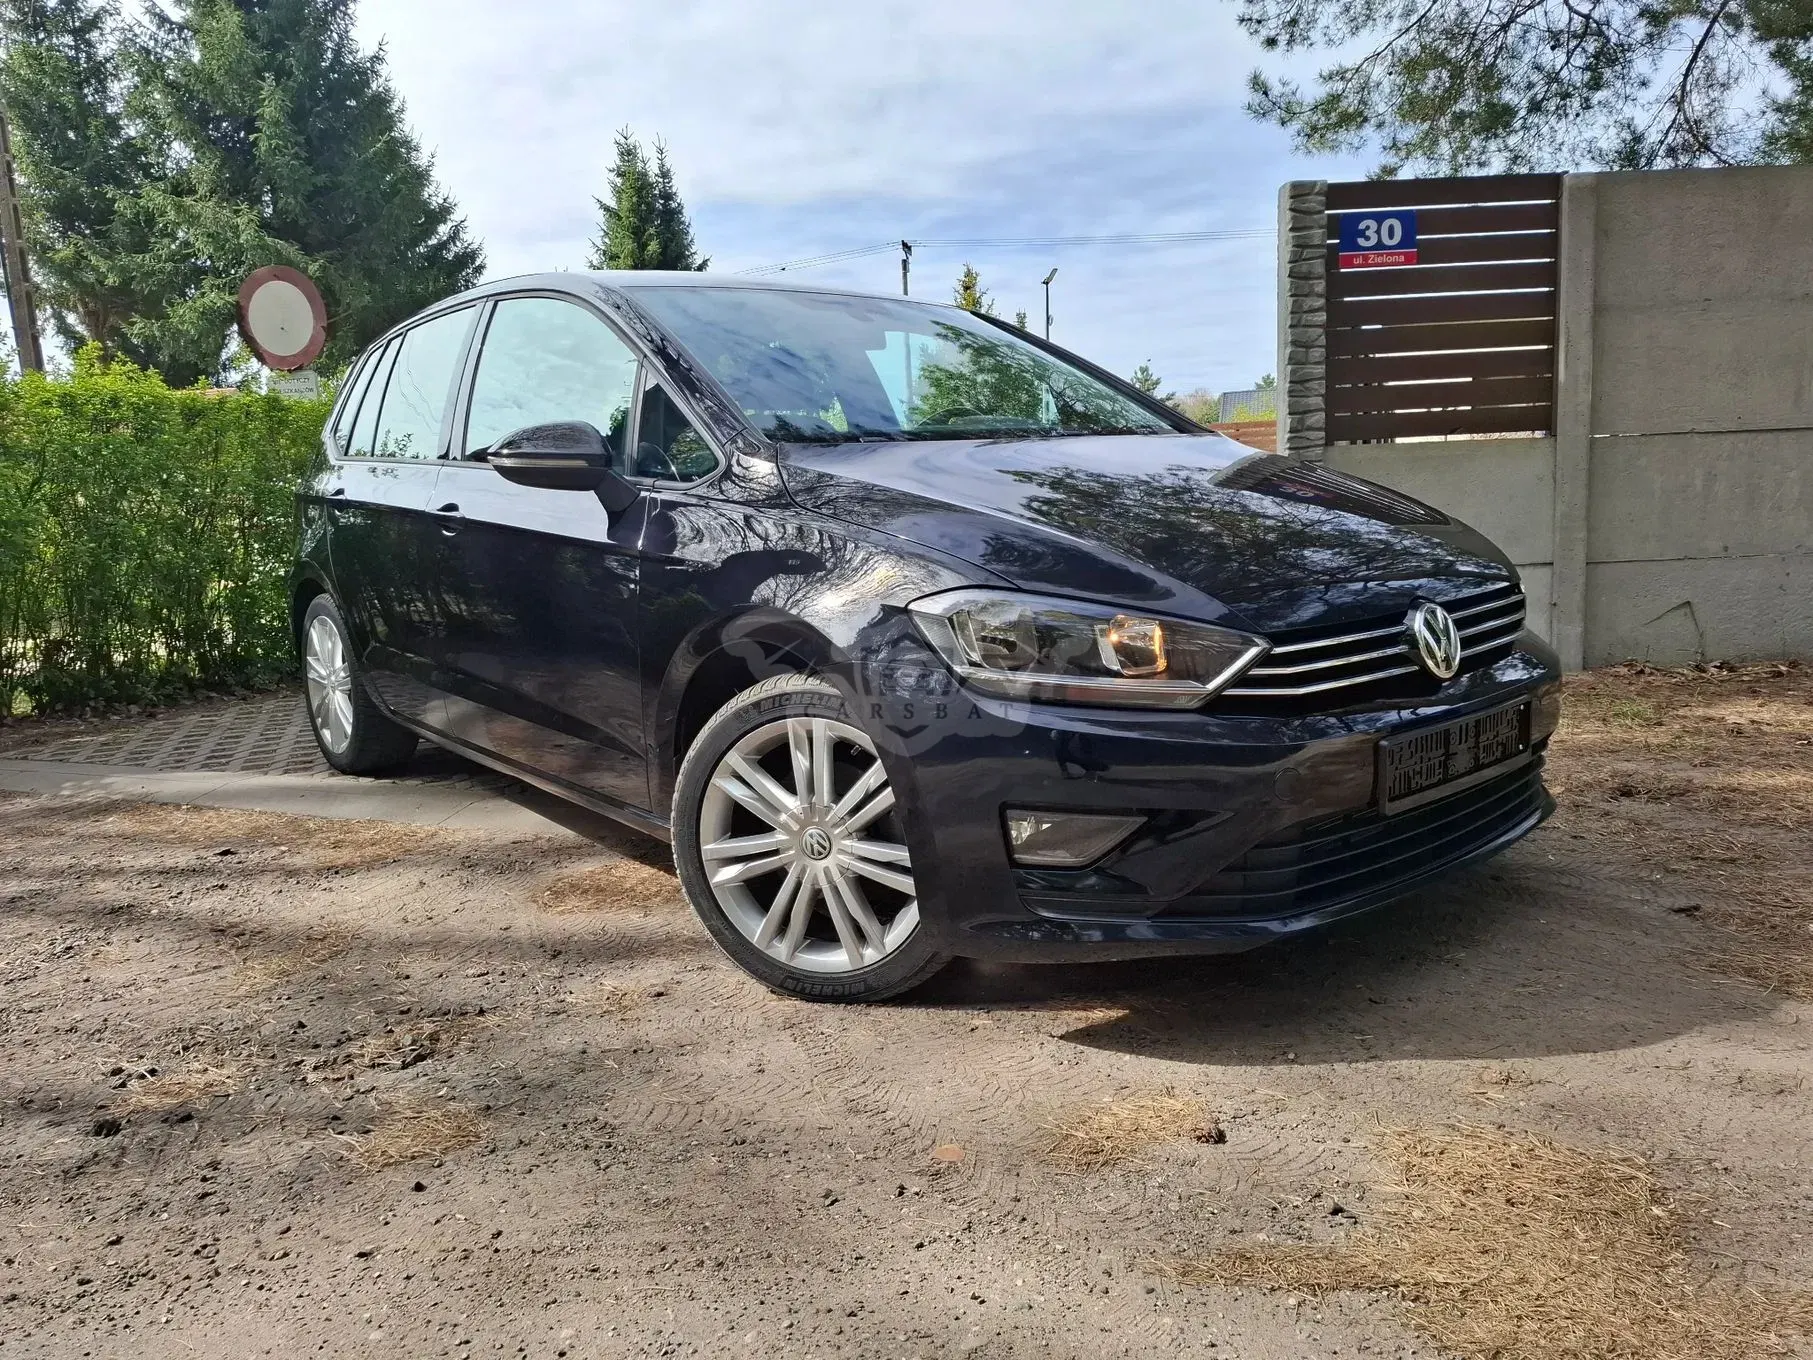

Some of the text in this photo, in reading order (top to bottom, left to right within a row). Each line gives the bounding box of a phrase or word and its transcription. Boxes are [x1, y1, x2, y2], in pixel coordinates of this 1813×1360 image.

[1356, 217, 1402, 247] 30
[1353, 254, 1405, 264] ul. Zielona
[760, 693, 842, 711] MICHELIN
[783, 979, 865, 997] MICHELIN
